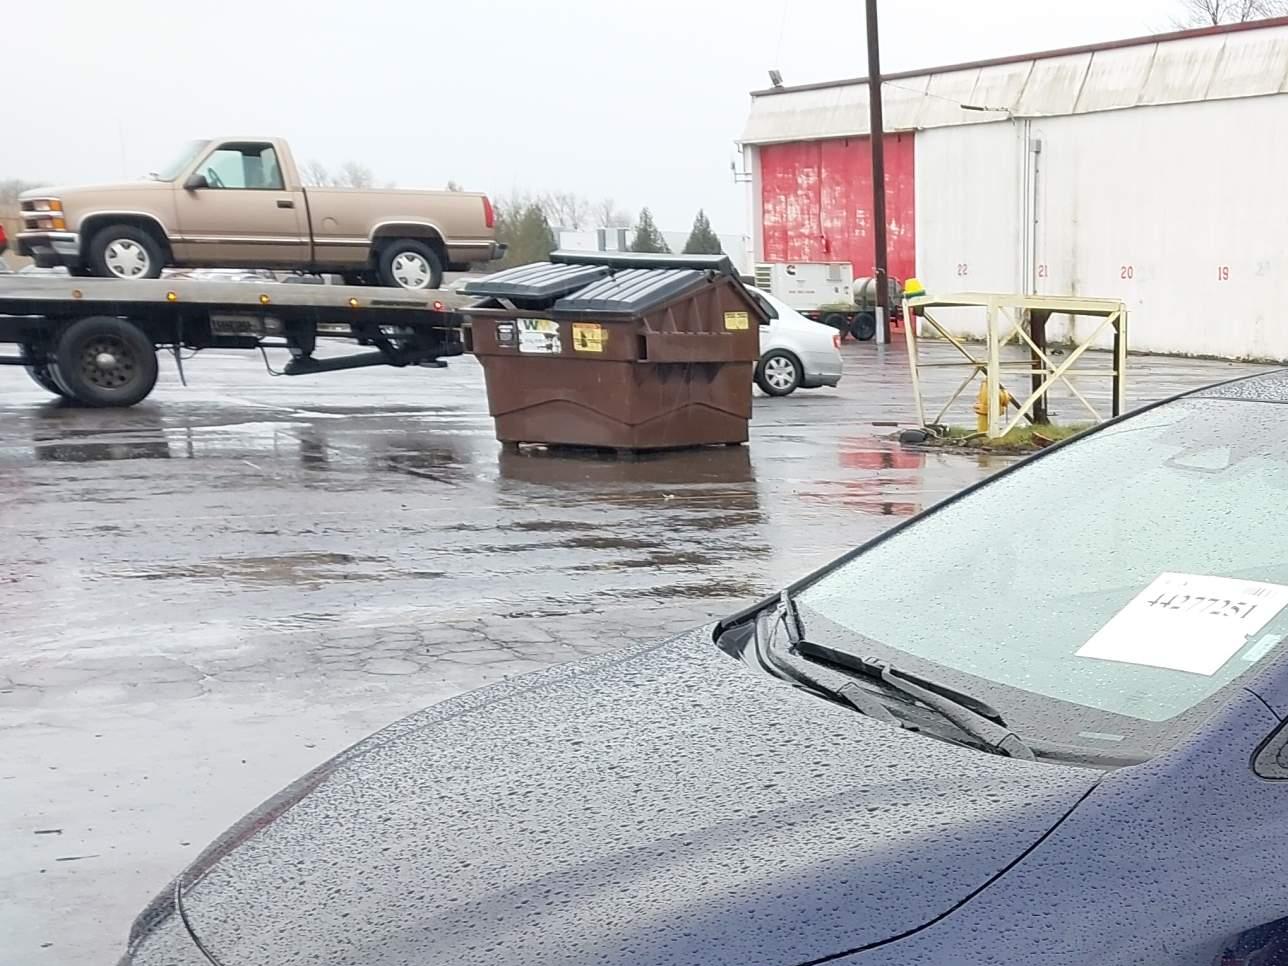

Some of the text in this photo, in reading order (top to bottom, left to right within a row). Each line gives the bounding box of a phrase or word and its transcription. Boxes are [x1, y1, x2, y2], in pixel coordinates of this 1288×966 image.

[957, 263, 968, 276] 22
[1038, 264, 1049, 277] 21
[1120, 266, 1134, 279] 20
[1218, 266, 1230, 281] 19
[1147, 593, 1258, 619] 44277251
